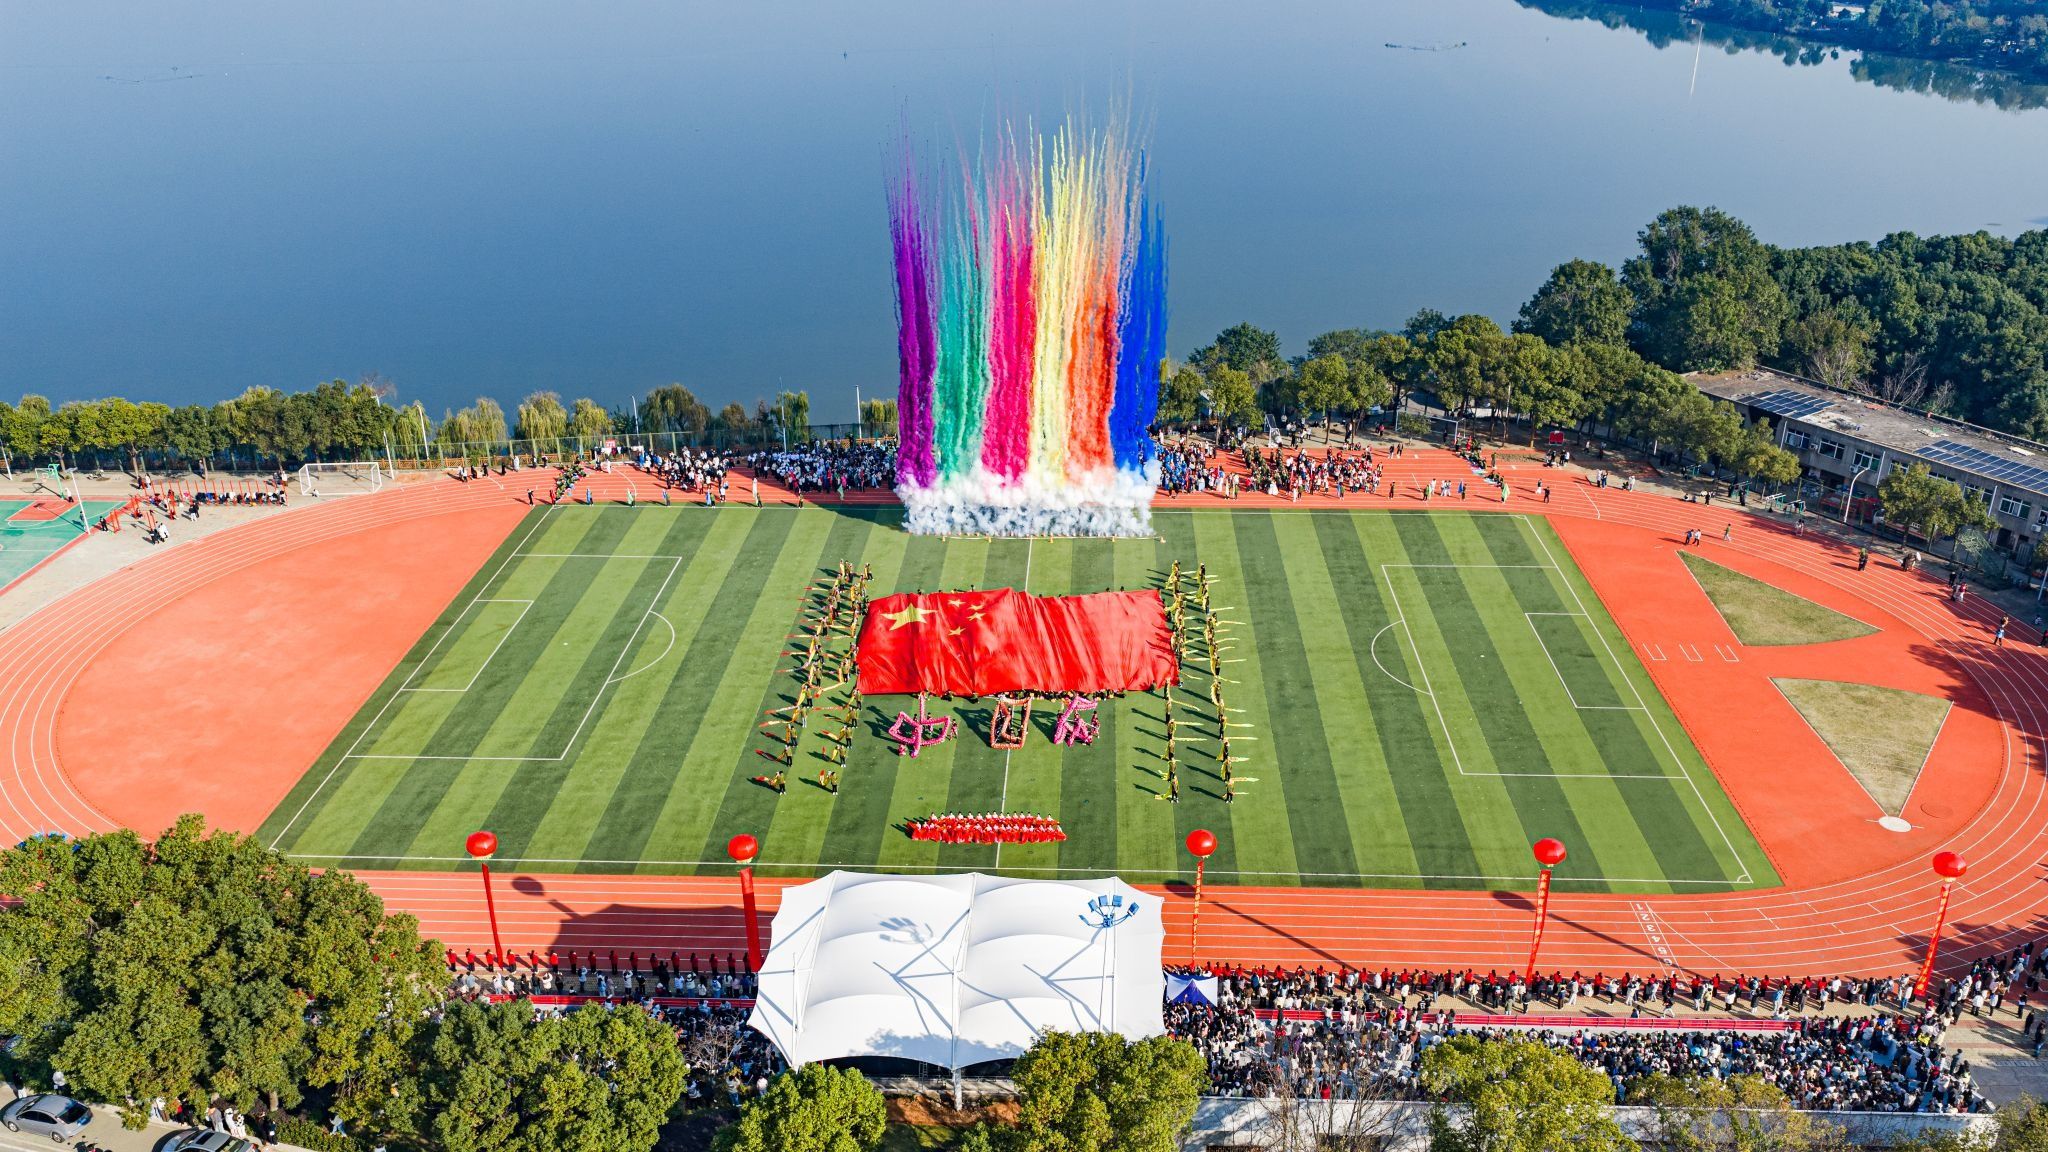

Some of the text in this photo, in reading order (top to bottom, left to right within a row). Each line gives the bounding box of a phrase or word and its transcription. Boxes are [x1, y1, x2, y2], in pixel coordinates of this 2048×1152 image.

[1635, 903, 1644, 911] 1
[1640, 913, 1650, 921] 2
[1646, 924, 1656, 932] 3
[1651, 935, 1661, 943] 4
